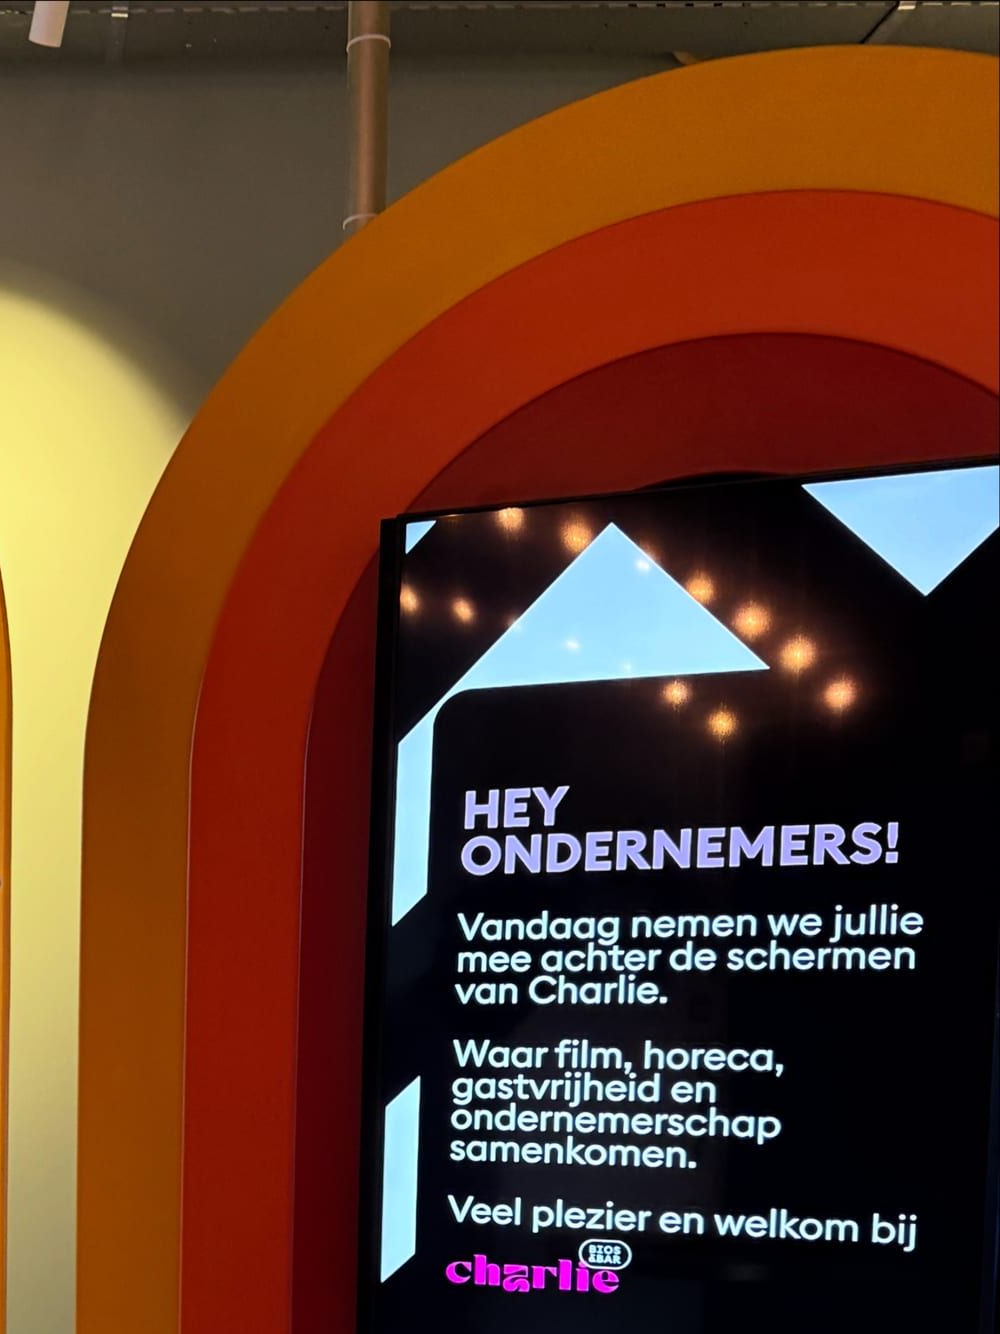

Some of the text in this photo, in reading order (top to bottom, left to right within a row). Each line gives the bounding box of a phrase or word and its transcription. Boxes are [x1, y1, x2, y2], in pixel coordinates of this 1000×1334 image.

[463, 785, 570, 830] HEY
[460, 821, 900, 876] ONDERNEMERS!
[457, 903, 924, 947] Vandaag nemen we jullie
[457, 939, 916, 973] mee achter de schermen
[454, 973, 668, 1005] van Charlie.
[452, 1038, 785, 1078] Waar film, horeca,
[451, 1070, 717, 1108] gastvrijheid en
[450, 1101, 782, 1146] ondernemerschap
[449, 1135, 698, 1170] samenkomen.
[447, 1194, 918, 1253] Veel plezier en welkom bij
[588, 1244, 621, 1255] BIOS
[588, 1254, 622, 1265] &BAR
[445, 1253, 620, 1294] charlie
